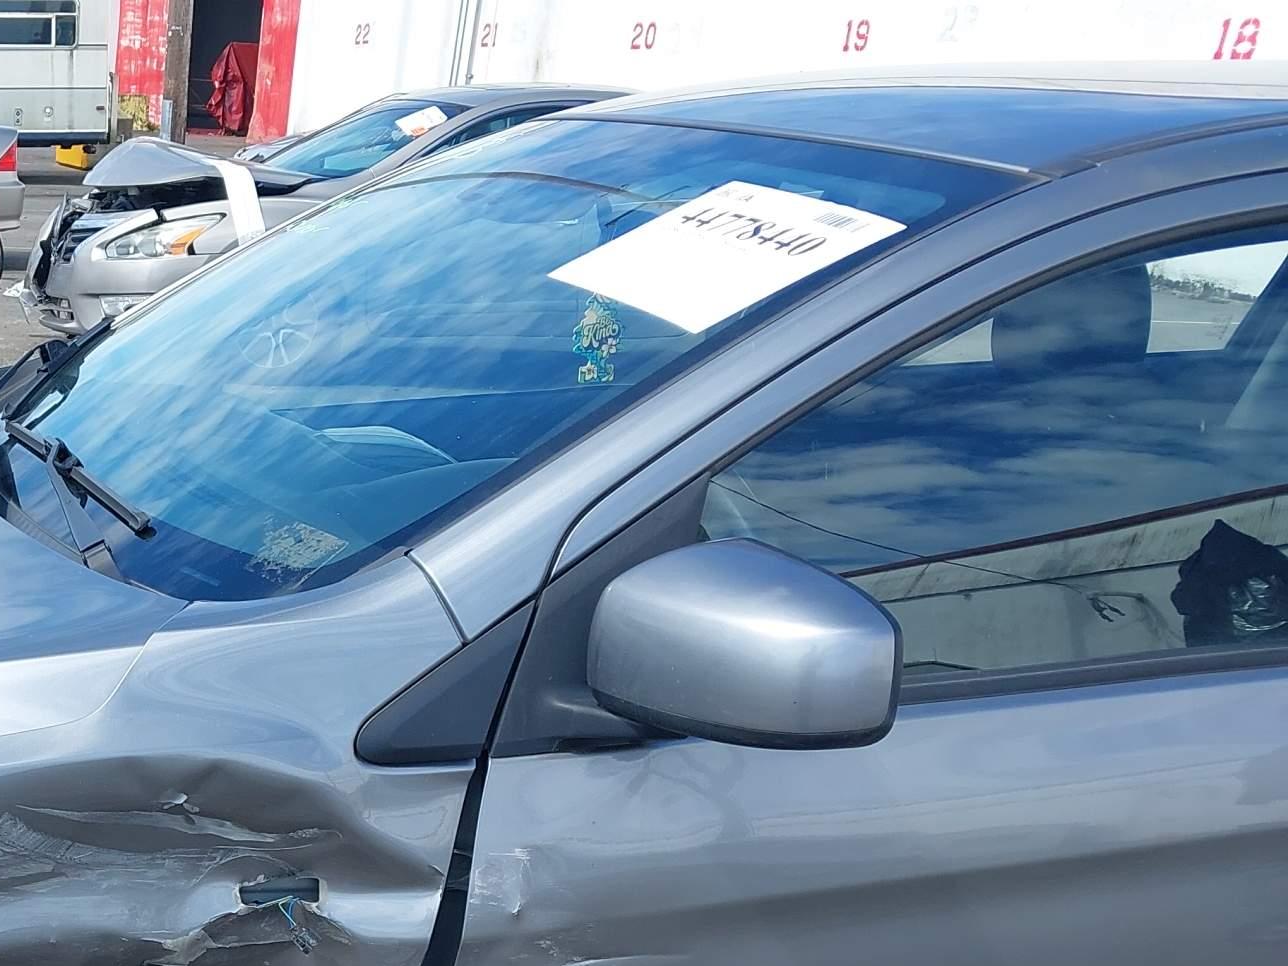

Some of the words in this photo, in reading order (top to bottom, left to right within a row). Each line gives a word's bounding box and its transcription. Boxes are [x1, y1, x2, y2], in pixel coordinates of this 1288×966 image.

[354, 23, 371, 45] 22
[480, 23, 498, 47] 21
[630, 21, 657, 50] 20
[842, 19, 870, 52] 19
[1213, 17, 1261, 60] 18
[681, 207, 827, 256] 44778440
[582, 322, 619, 348] Kind
